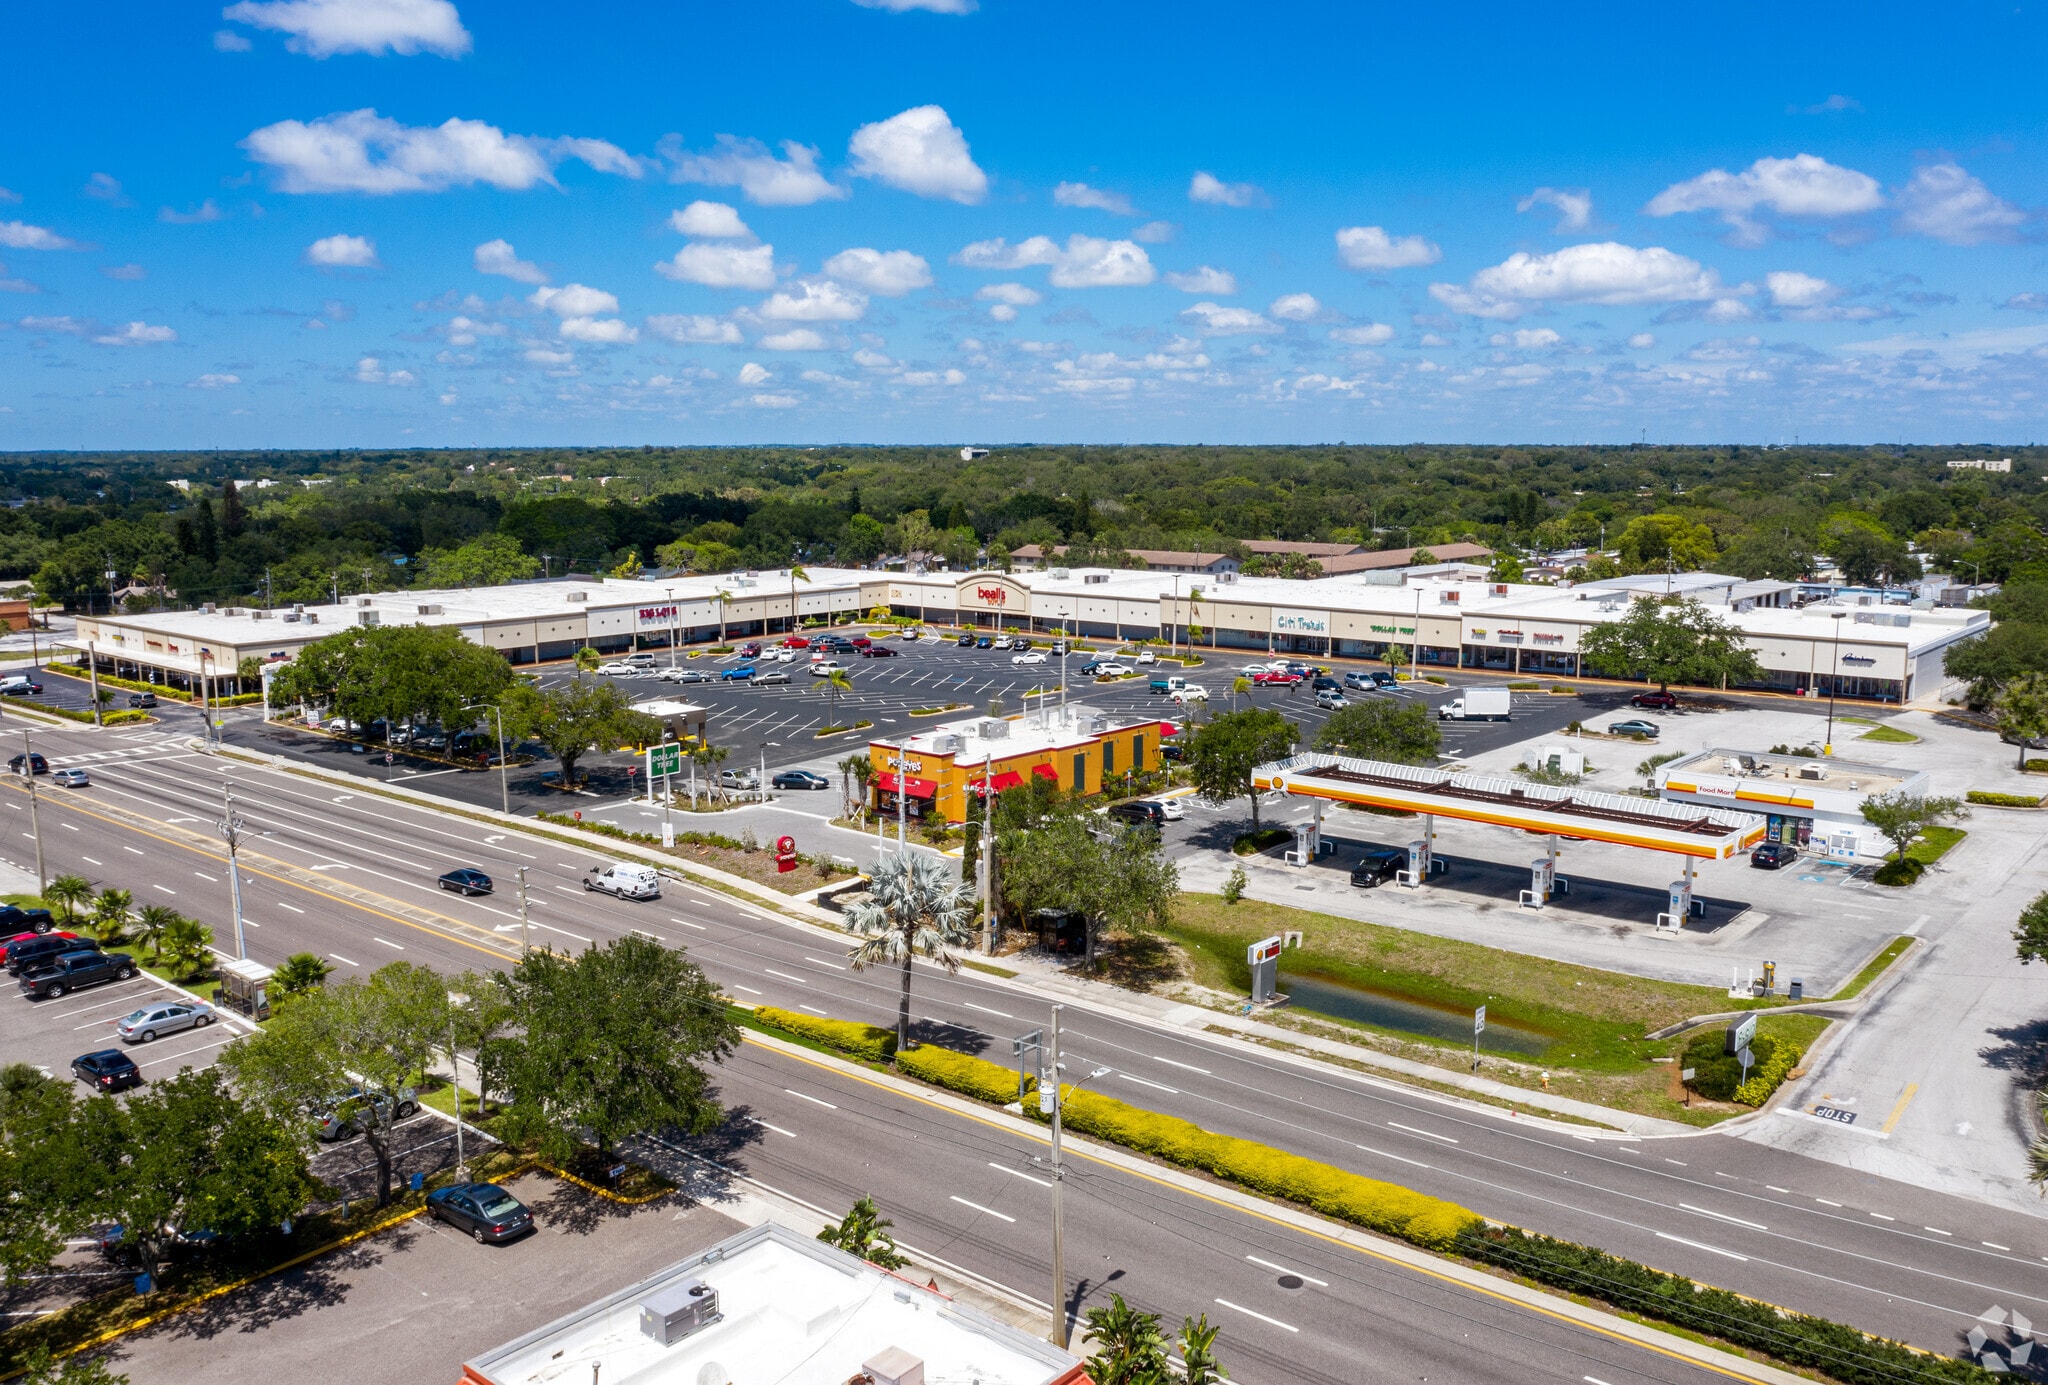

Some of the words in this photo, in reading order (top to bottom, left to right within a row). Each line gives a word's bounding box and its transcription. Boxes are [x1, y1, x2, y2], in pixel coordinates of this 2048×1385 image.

[1277, 615, 1296, 629] Citi
[1297, 616, 1325, 632] Trends
[1699, 785, 1716, 794] Food
[1816, 1107, 1852, 1123] STOP
